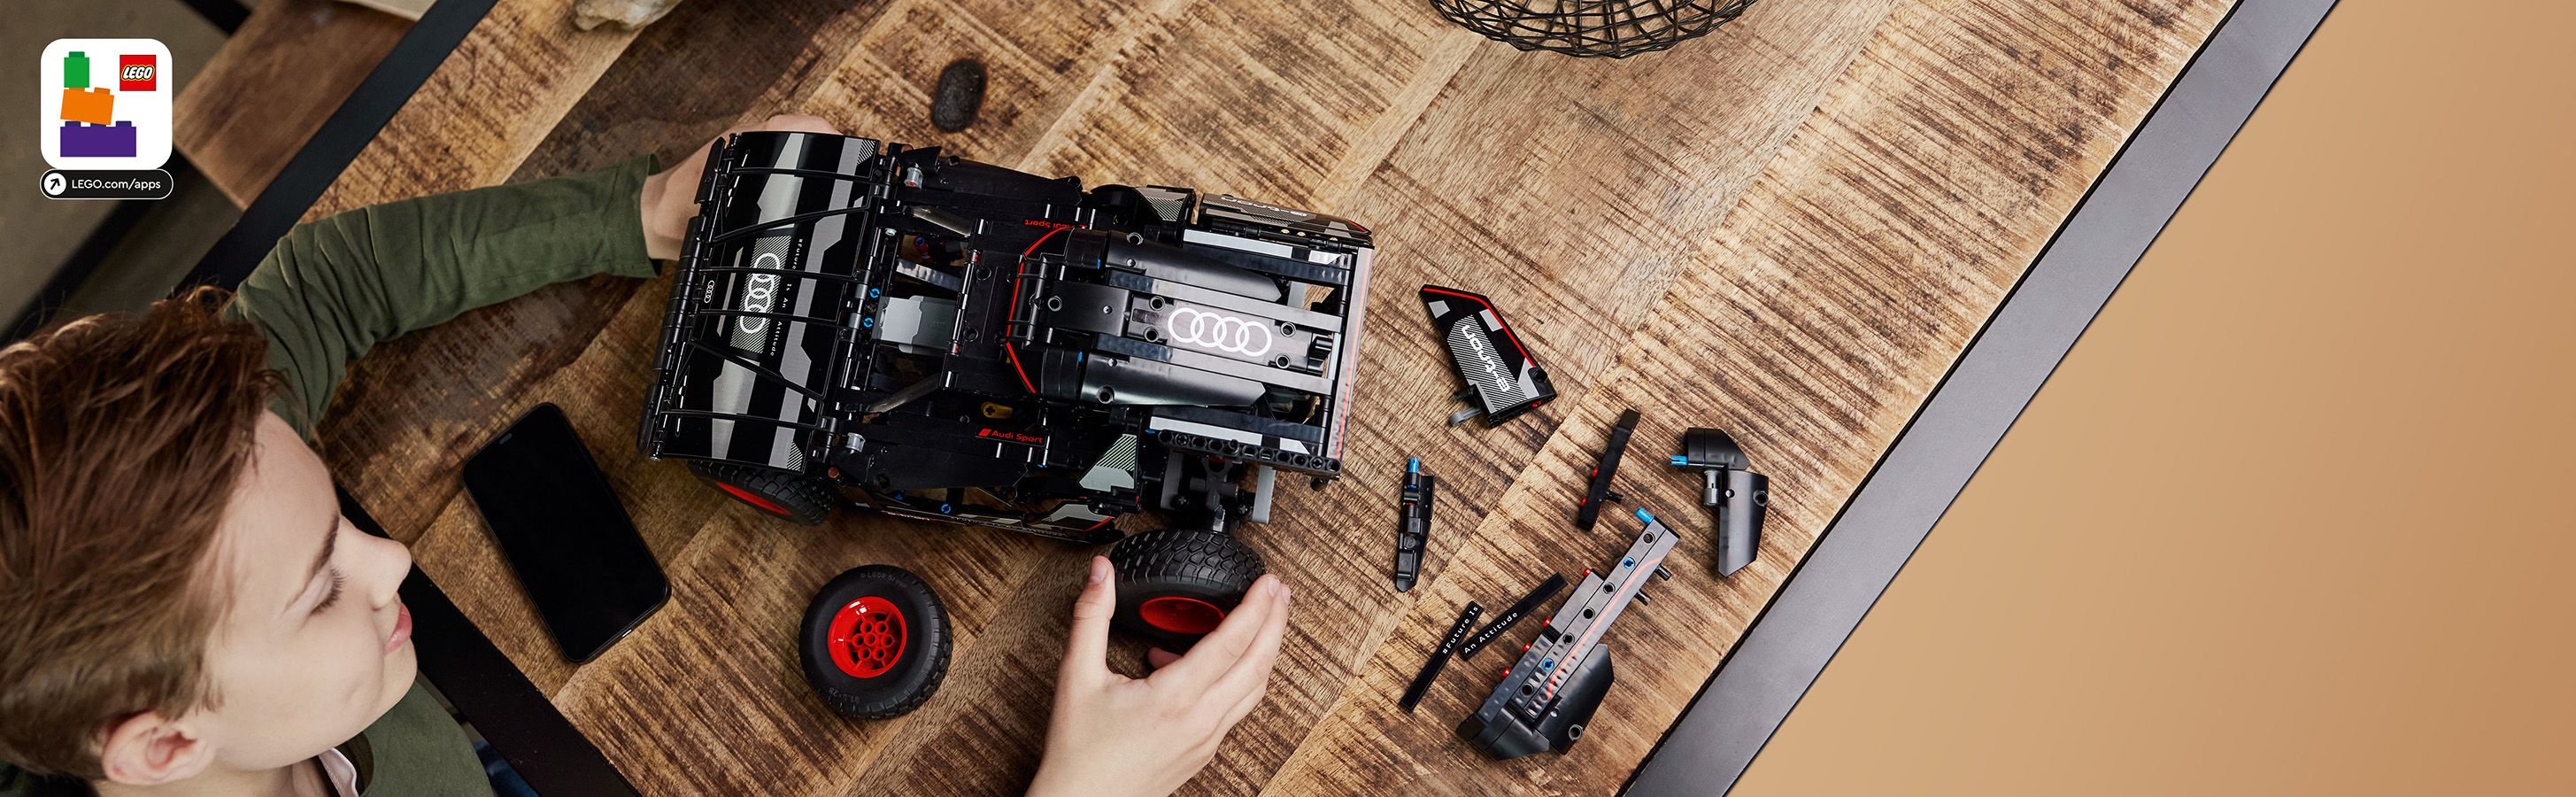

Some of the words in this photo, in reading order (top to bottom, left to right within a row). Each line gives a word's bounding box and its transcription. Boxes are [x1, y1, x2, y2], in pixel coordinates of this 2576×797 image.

[1024, 219, 1051, 228] Sport
[770, 321, 783, 357] Attitude
[1461, 324, 1510, 392] e-tron
[991, 429, 1014, 439] Audi
[1015, 433, 1044, 443] Sport
[1442, 618, 1470, 654] #Future
[1469, 606, 1478, 615] Is
[1464, 643, 1477, 654] An
[1478, 612, 1518, 643] Attitude
